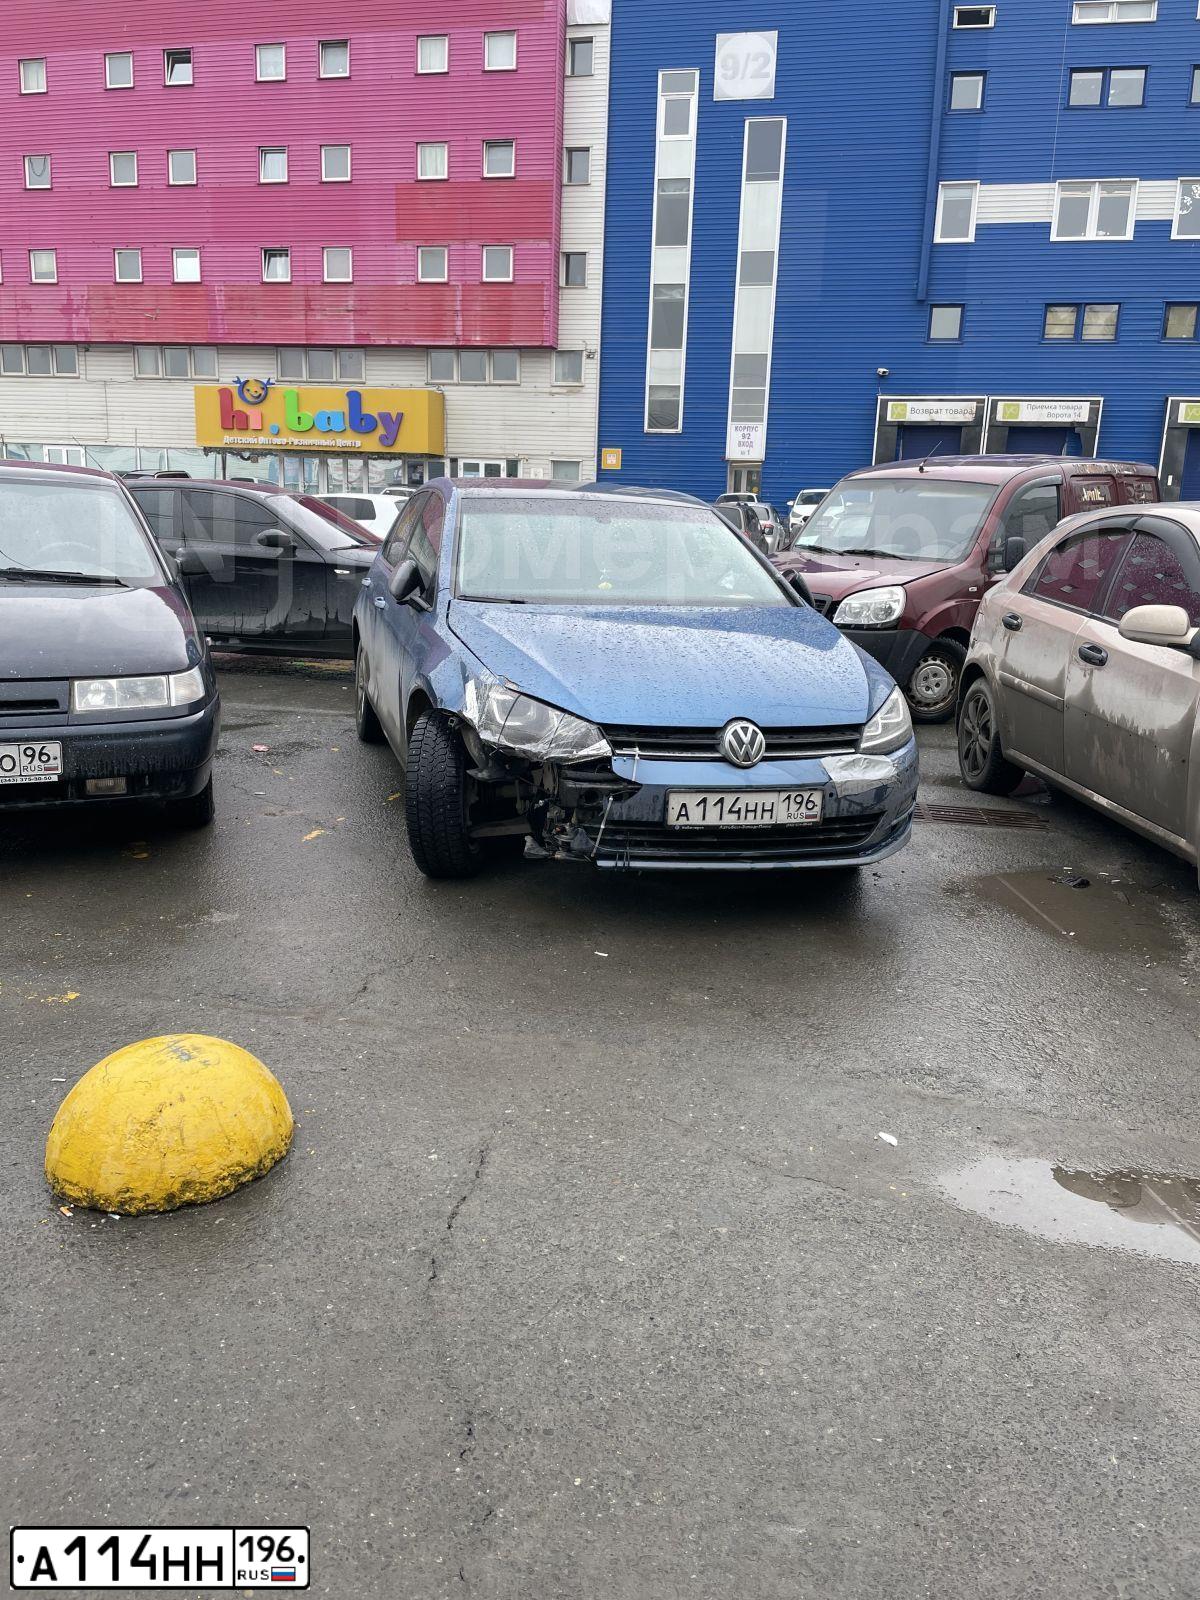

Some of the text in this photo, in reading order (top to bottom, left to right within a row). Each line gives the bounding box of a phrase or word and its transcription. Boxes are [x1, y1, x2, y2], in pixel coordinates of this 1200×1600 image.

[720, 52, 771, 80] 9/2
[910, 406, 943, 417] Возврат
[945, 407, 976, 417] товара
[1026, 403, 1057, 412] Приемка
[1059, 404, 1083, 413] товара
[1046, 411, 1072, 419] Ворота
[223, 435, 257, 445] Детский
[737, 440, 754, 448] ВХОД
[23, 746, 51, 764] 96
[782, 792, 817, 812] 196
[786, 811, 805, 820] RUS
